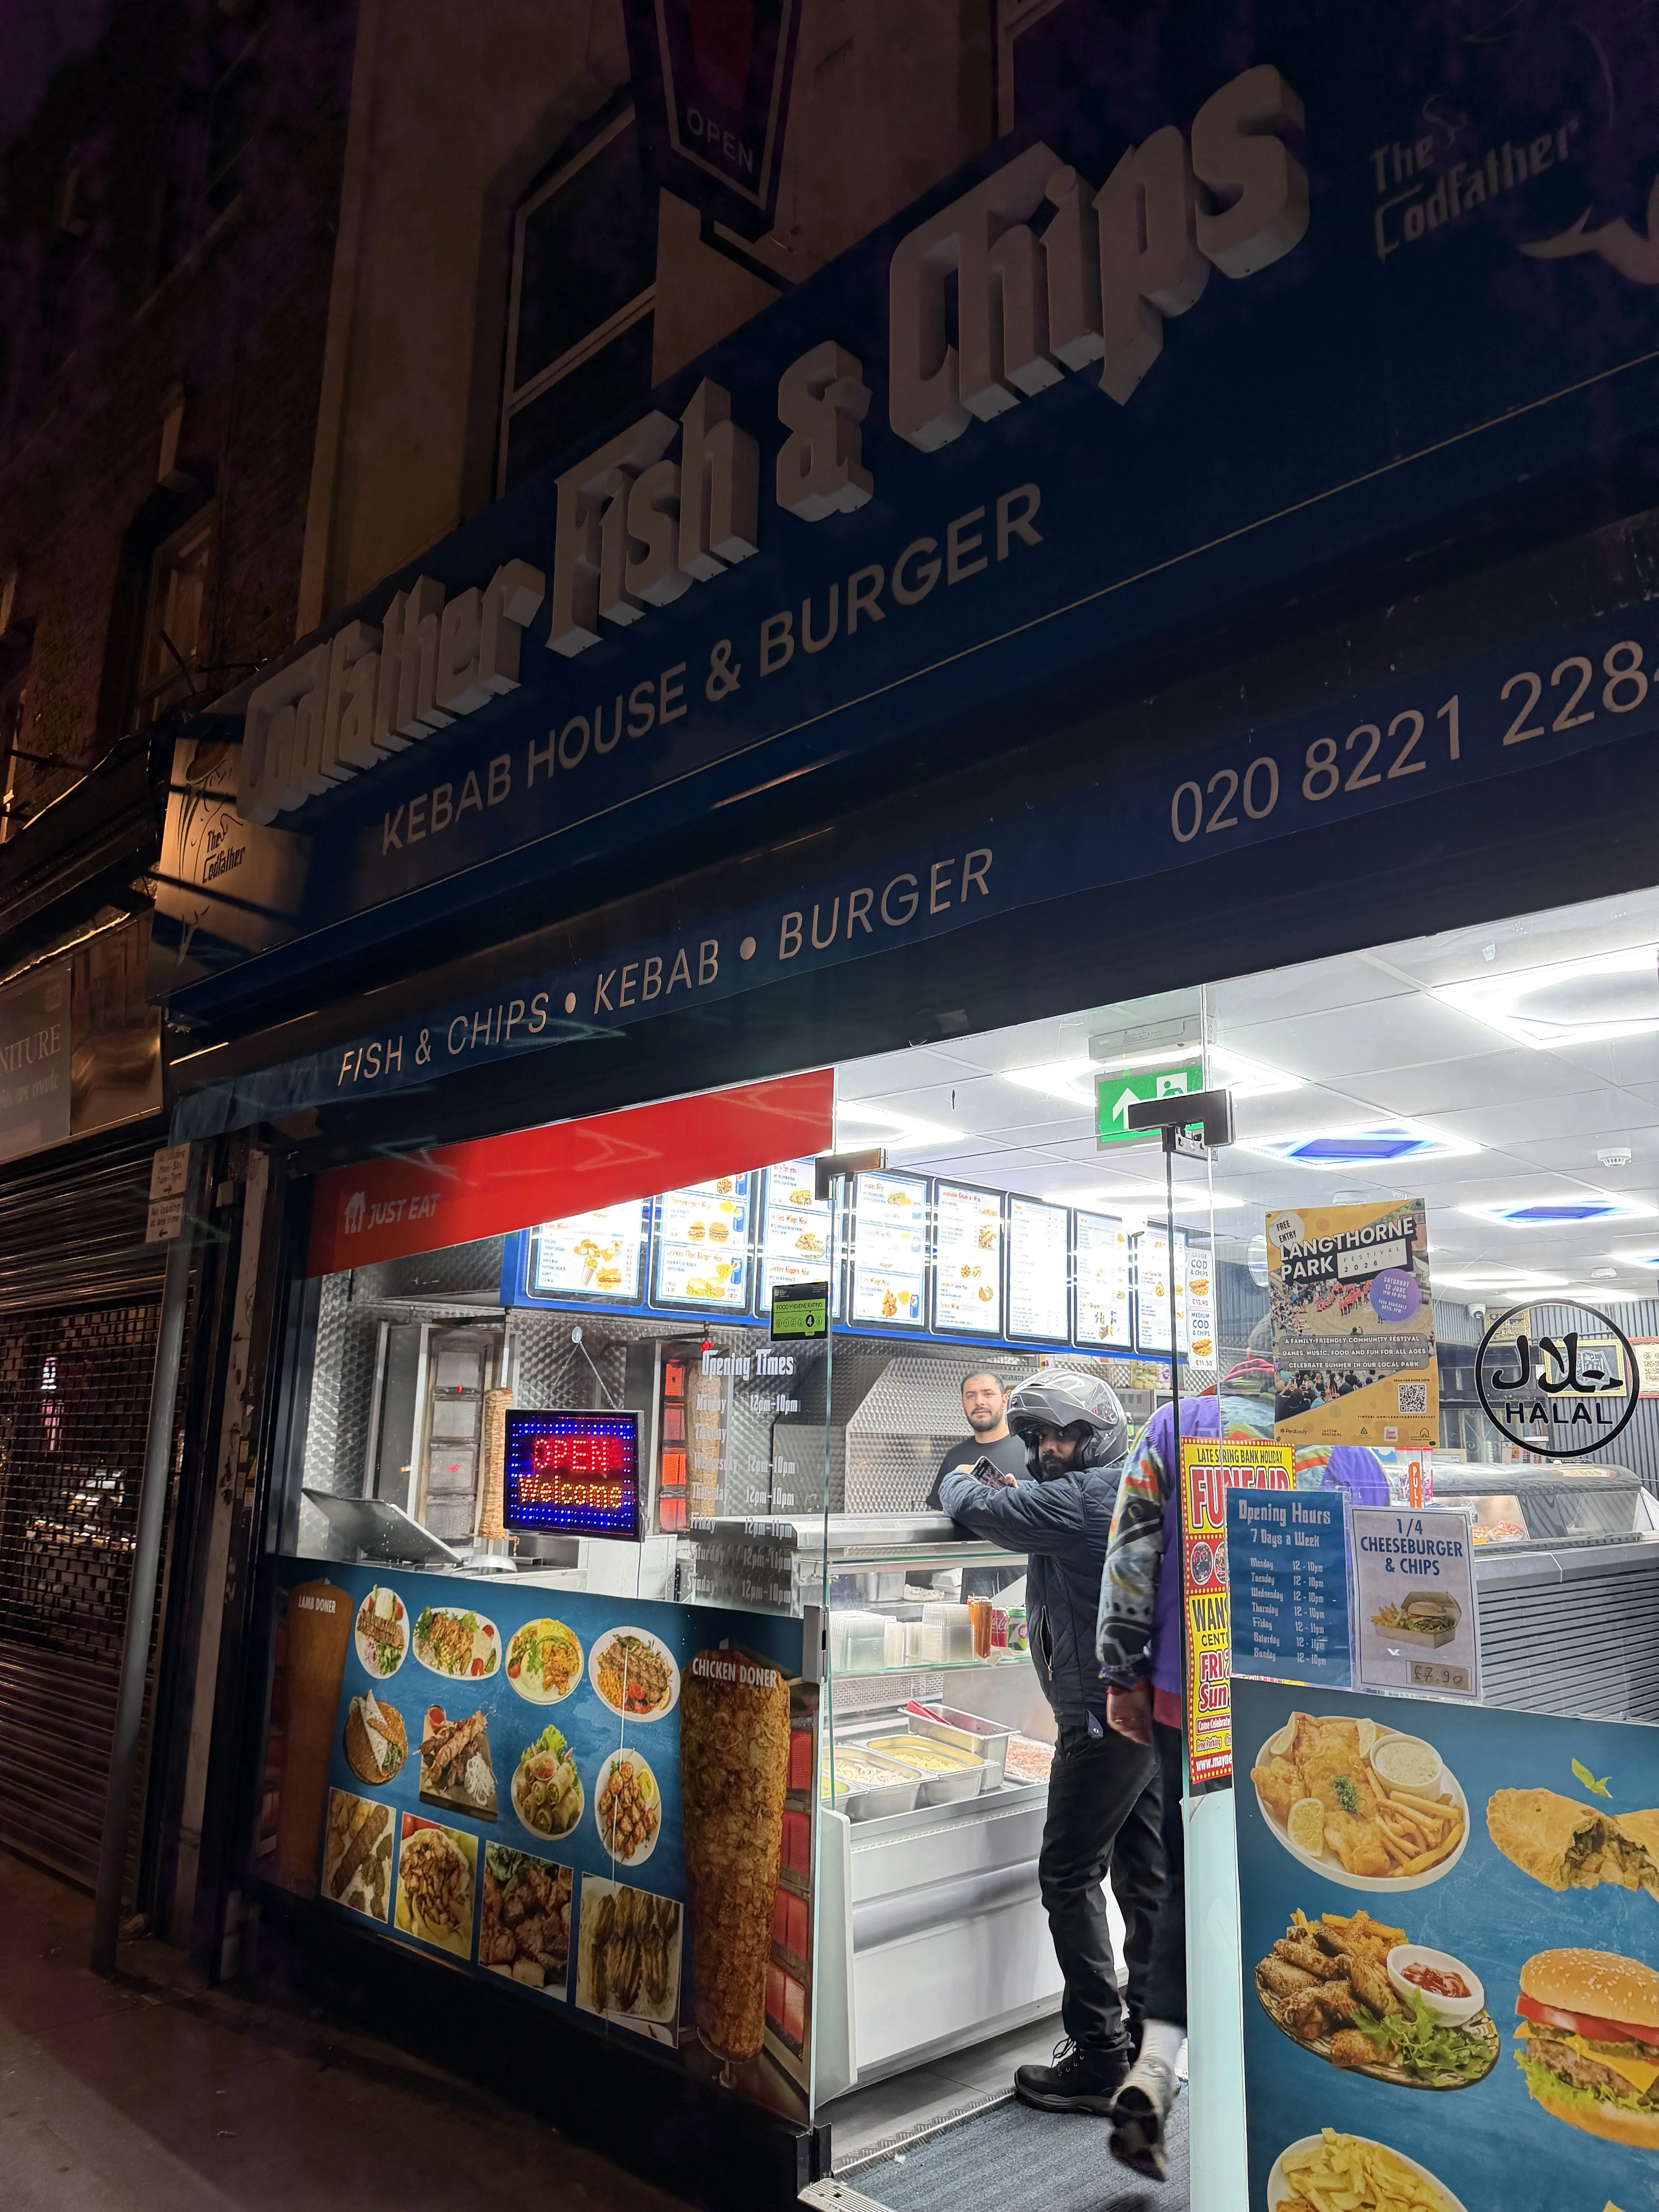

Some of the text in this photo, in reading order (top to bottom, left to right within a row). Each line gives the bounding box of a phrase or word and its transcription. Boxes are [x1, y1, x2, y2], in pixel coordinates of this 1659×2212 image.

[687, 107, 753, 174] OPEN
[1369, 134, 1434, 194] The
[1374, 117, 1580, 266] Codfather
[237, 63, 1310, 826] Codfather Fish & Chips
[382, 482, 1043, 855] KEBAB HOUSE & BURGER
[1171, 640, 1659, 843] 020 8221 228
[207, 829, 222, 853] The
[203, 846, 246, 883] Codfather
[337, 847, 994, 1087] FISH & CHIPS KEBAB BURGER
[368, 1193, 441, 1230] JUST EAT
[1276, 1220, 1291, 1231] FREE
[1279, 1230, 1297, 1243] ENTRY
[1279, 1217, 1414, 1261] LANGTHORNE
[1191, 1259, 1207, 1269] COD
[1281, 1247, 1400, 1281] PARK FESTIVAL
[1344, 1261, 1377, 1273] 2026
[1384, 1277, 1410, 1287] SATURDAY
[1388, 1302, 1407, 1310] AVAILABLE
[807, 1316, 812, 1326] 4
[1193, 1320, 1209, 1329] COD
[702, 1348, 795, 1381] Opening Times
[1492, 1332, 1623, 1393] حلال
[1505, 1402, 1613, 1425] HALAL
[534, 1438, 609, 1473] OPEN
[1197, 1448, 1283, 1464] LATE BANK HOLIDAY
[519, 1473, 623, 1509] Welcome
[690, 1511, 716, 1534] Friday
[1239, 1499, 1331, 1527] Opening Hours
[1396, 1518, 1423, 1537] 1/4
[1250, 1528, 1319, 1548] 7 Days a Week
[1360, 1536, 1463, 1557] CHEESEBURGER
[1250, 1557, 1323, 1574] Monday 12 10pm
[1385, 1558, 1440, 1576] & CHIPS
[1251, 1573, 1324, 1589] Tuesday 12 10pm
[298, 1595, 336, 1614] LAMB DONER
[1251, 1587, 1324, 1605] Wednesday 12 10pm
[1252, 1602, 1325, 1620] Thursday 12 10pm
[1253, 1617, 1324, 1635] Friday 12 11pm
[1254, 1632, 1325, 1651] Saturday 12 11pm
[1200, 1651, 1223, 1681] FRI
[1254, 1647, 1326, 1666] Sunday 12 10pm
[692, 1657, 777, 1688] CHICKEN DONER
[1413, 1665, 1463, 1684] £7.90
[1200, 1683, 1227, 1711] Sun
[1198, 1717, 1230, 1731] Come Celebrate
[1197, 1741, 1206, 1751] Free
[1206, 1737, 1221, 1750] Parking
